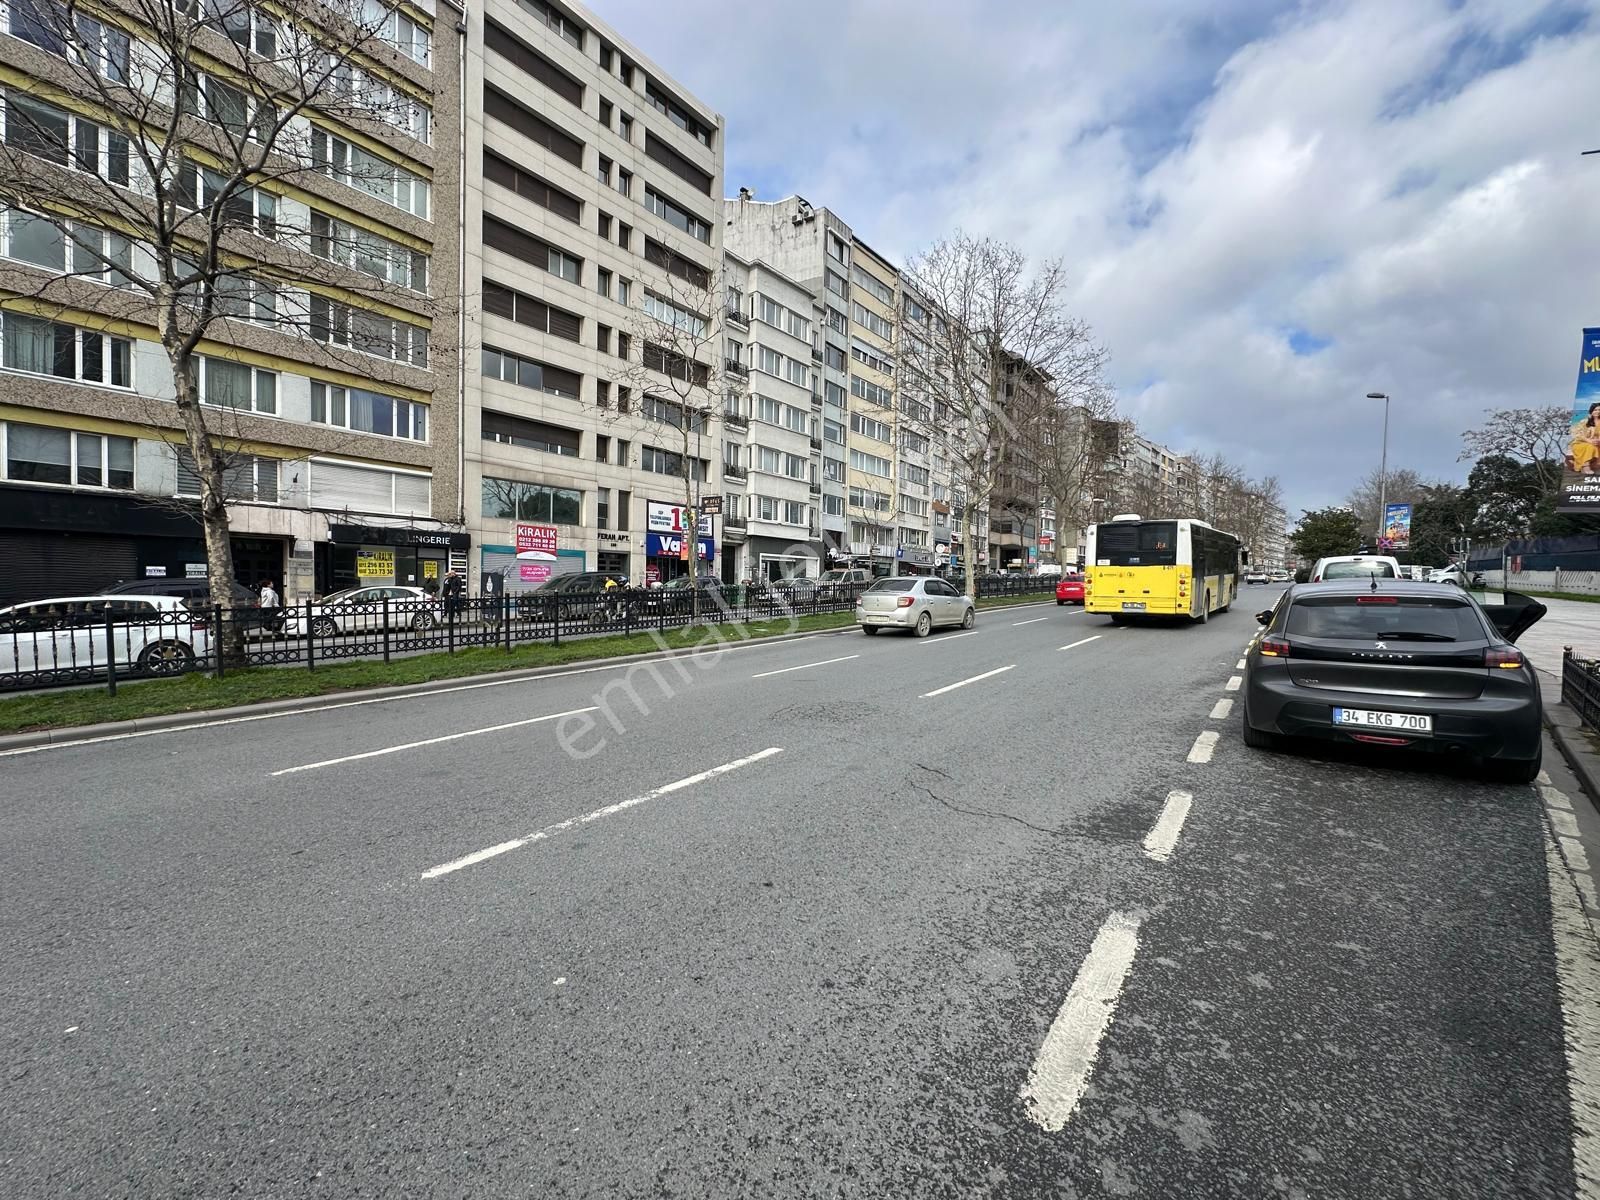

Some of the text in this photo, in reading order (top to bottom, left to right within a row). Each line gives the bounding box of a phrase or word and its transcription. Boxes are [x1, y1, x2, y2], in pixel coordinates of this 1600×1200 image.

[1566, 484, 1600, 492] SİNEM
[407, 535, 451, 545] LINGERIE
[660, 536, 706, 554] Van
[1343, 710, 1359, 723] 34
[1367, 712, 1393, 726] EKG
[1400, 715, 1427, 729] 700
